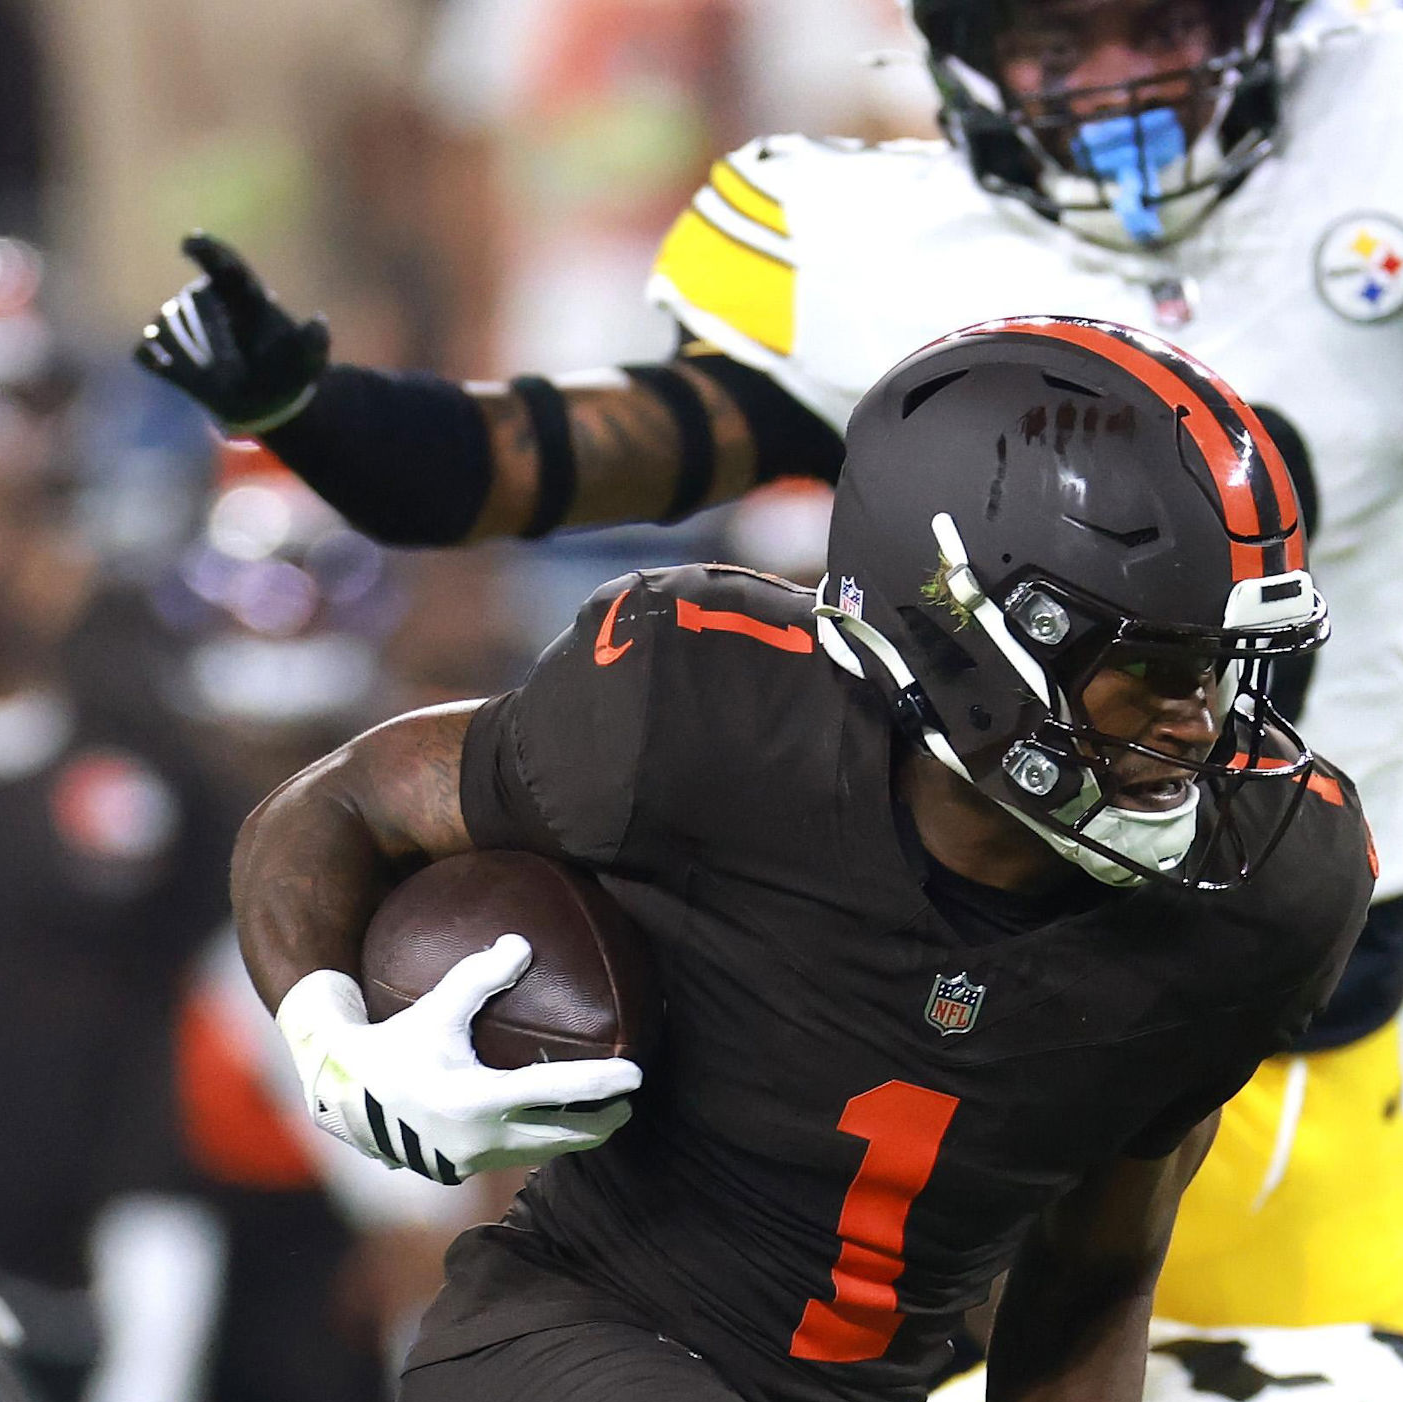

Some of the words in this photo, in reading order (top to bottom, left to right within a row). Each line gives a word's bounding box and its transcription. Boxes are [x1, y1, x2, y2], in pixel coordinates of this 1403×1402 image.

[677, 598, 814, 654] 1
[932, 1000, 969, 1026] NFL
[790, 1079, 959, 1362] 1
